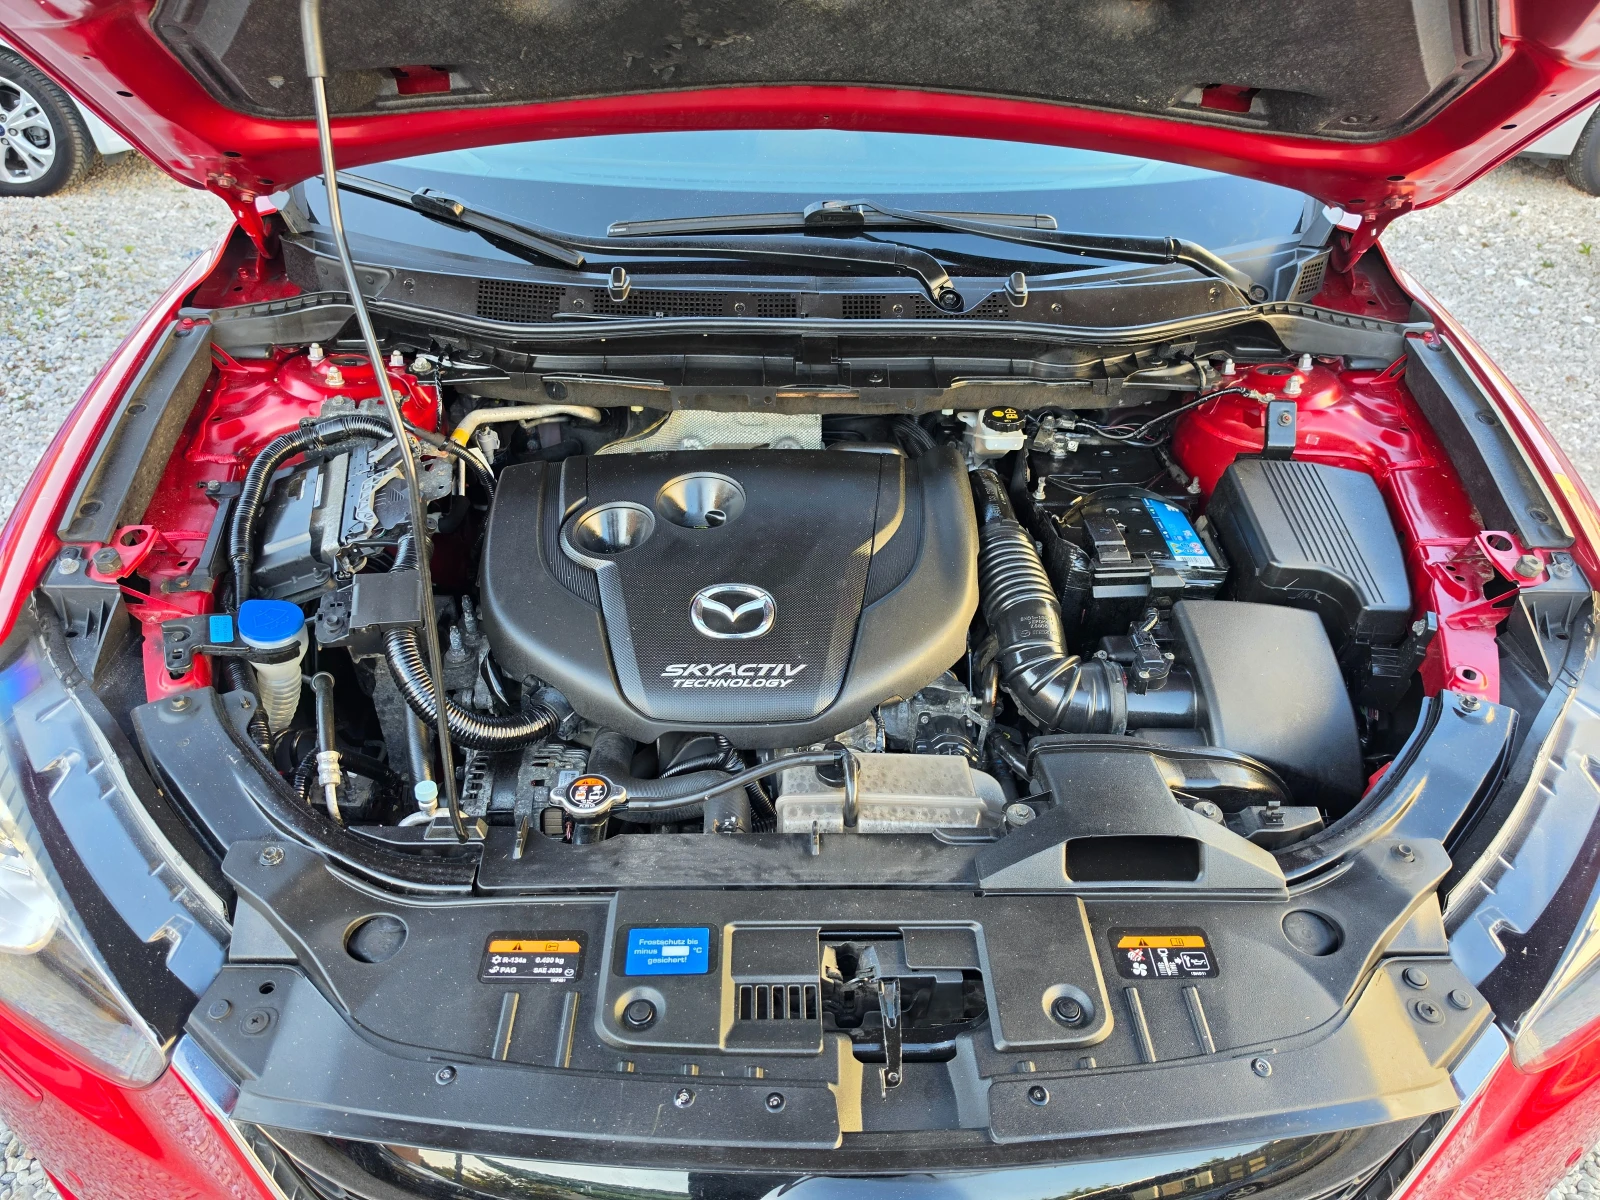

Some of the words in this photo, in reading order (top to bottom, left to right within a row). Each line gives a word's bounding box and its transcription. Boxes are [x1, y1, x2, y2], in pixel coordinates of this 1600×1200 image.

[660, 663, 808, 677] SKYACTIV
[672, 678, 794, 688] TECHNOLOGY
[638, 938, 686, 946] Frostschutz
[633, 947, 658, 955] minus
[647, 956, 687, 966] gesichert!
[499, 966, 517, 974] PAG
